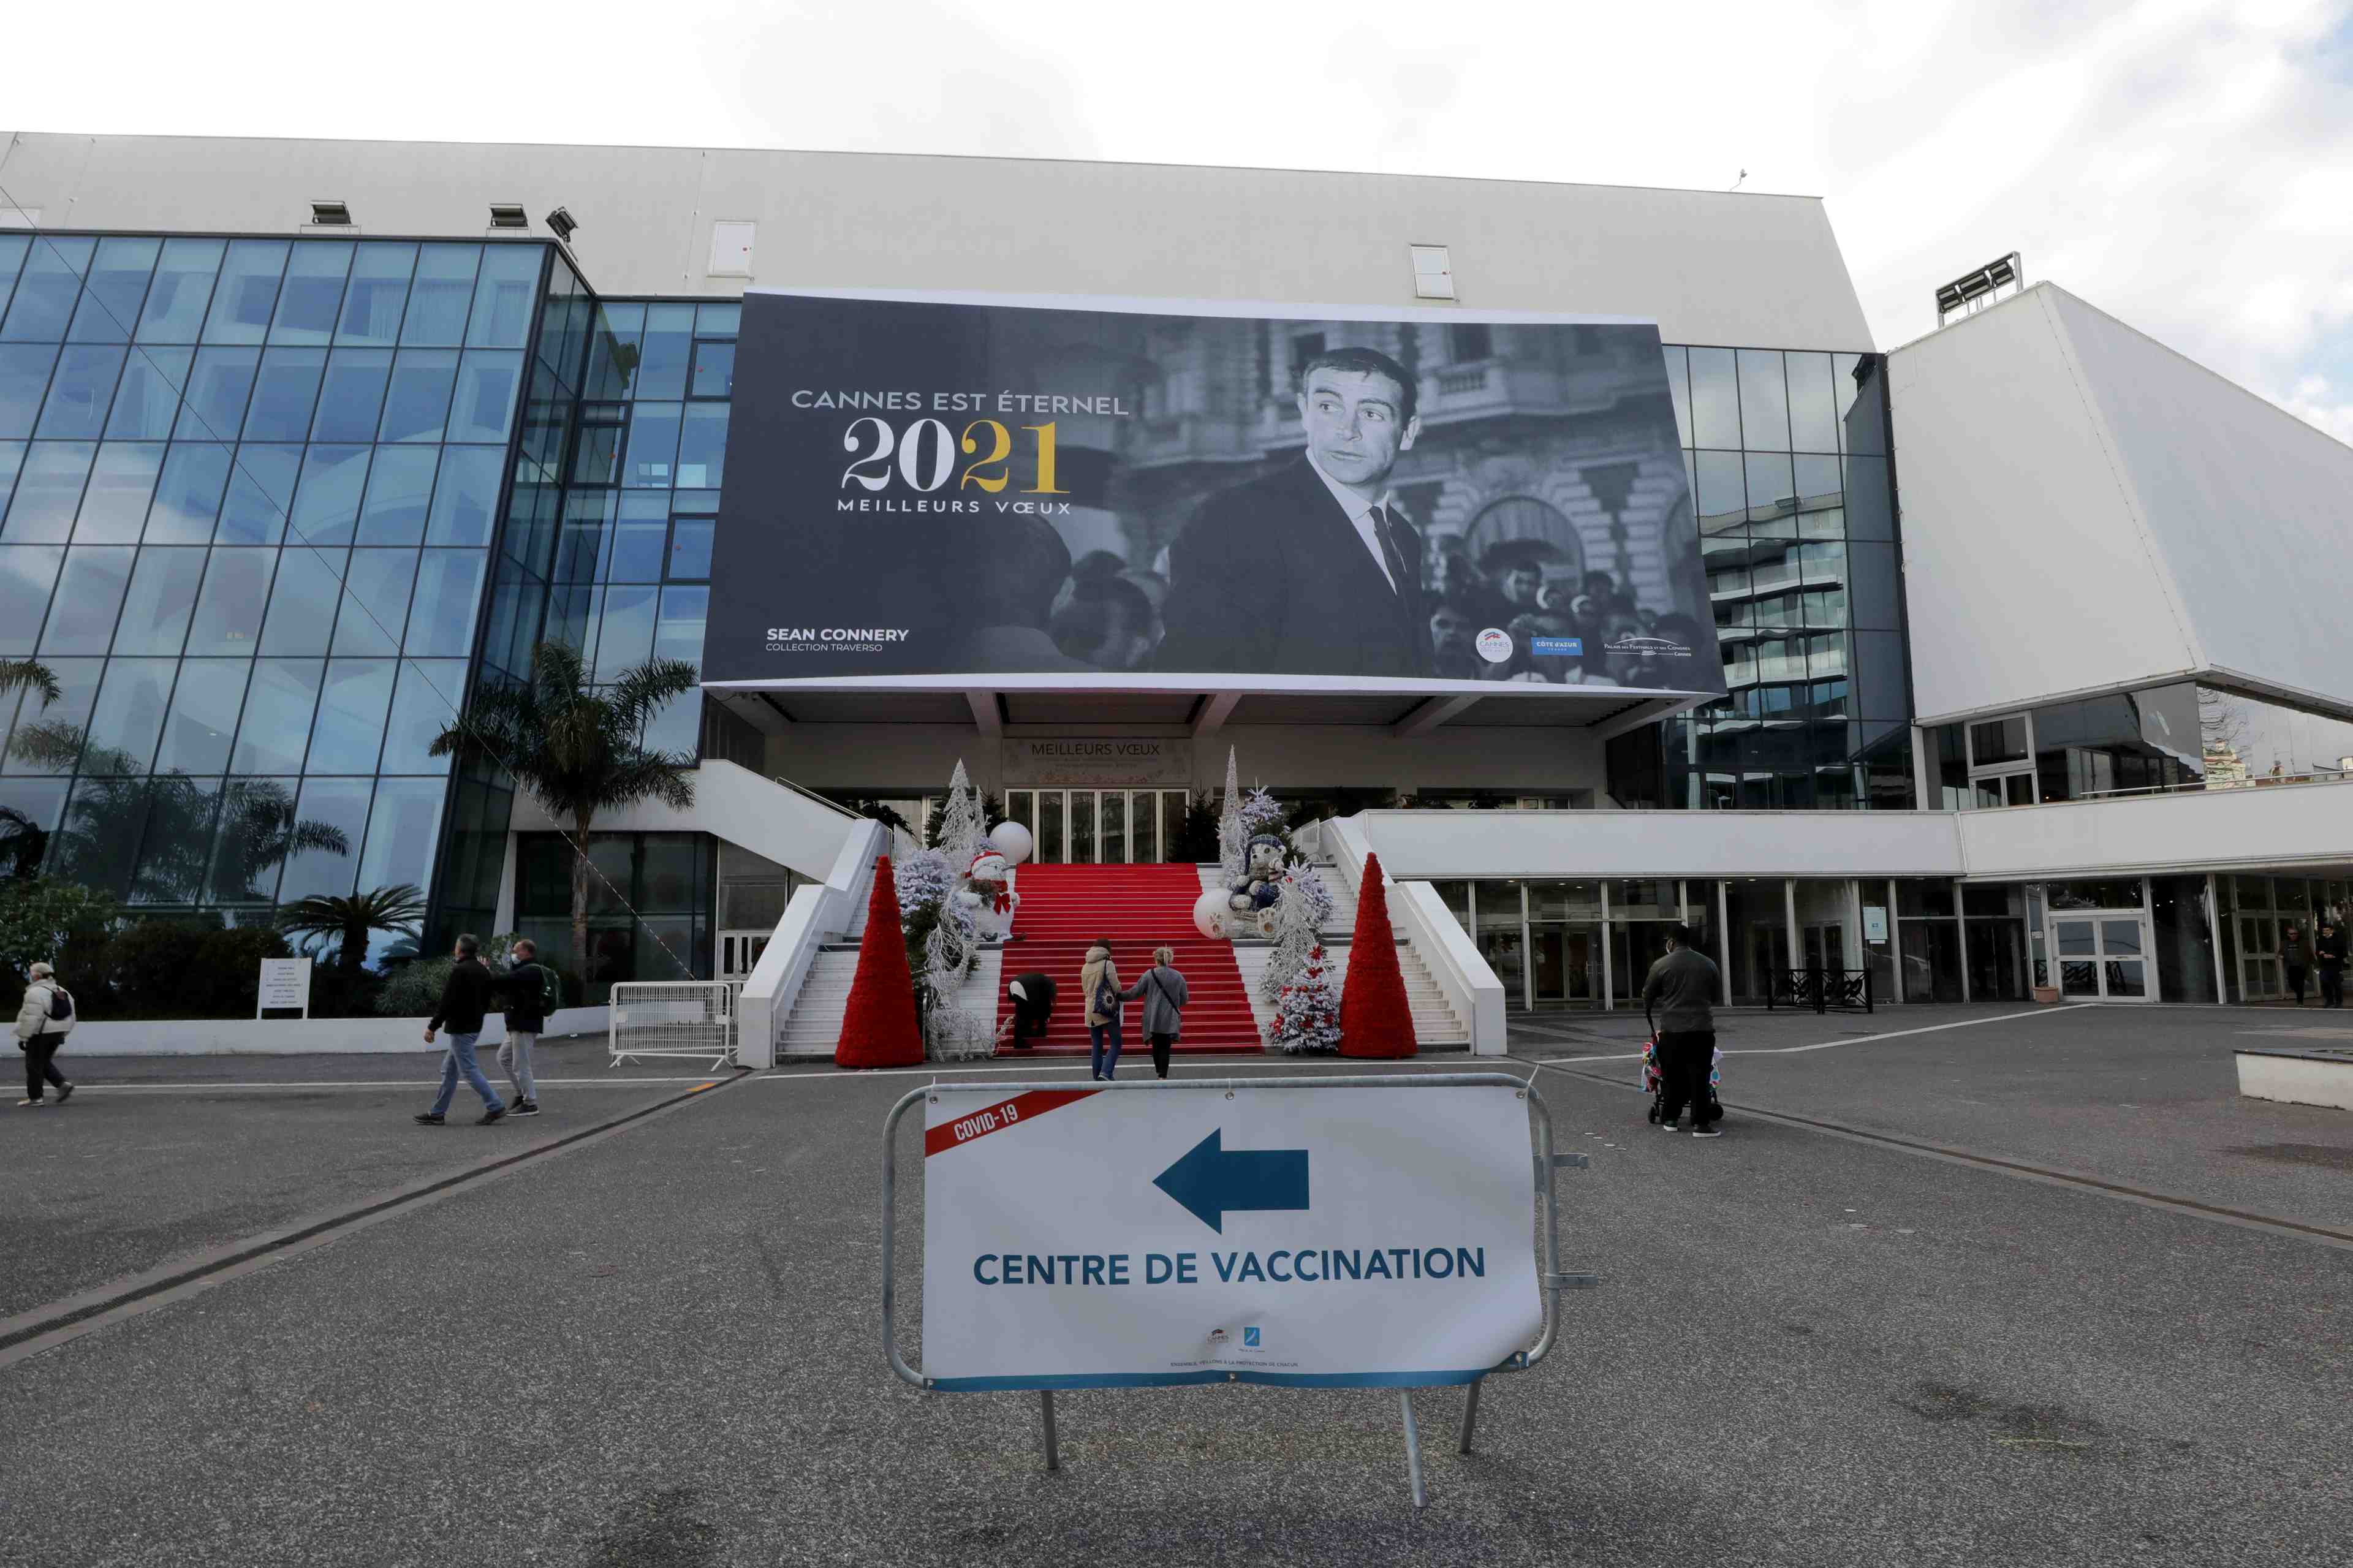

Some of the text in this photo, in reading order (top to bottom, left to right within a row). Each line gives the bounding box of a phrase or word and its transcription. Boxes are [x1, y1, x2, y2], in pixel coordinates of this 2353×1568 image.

[791, 390, 1129, 415] CANNES EST ÉTERNEL
[841, 417, 1070, 494] 2021
[837, 499, 1070, 515] MEILLEURS VŒUX
[767, 628, 910, 642] SEAN CONNERY
[765, 643, 883, 652] COLLECTION TRAVERSO
[1032, 743, 1161, 756] MEILLEURS VŒUX
[953, 1104, 1019, 1142] COVID-19
[973, 1247, 1486, 1286] CENTRE DE VACCINATION
